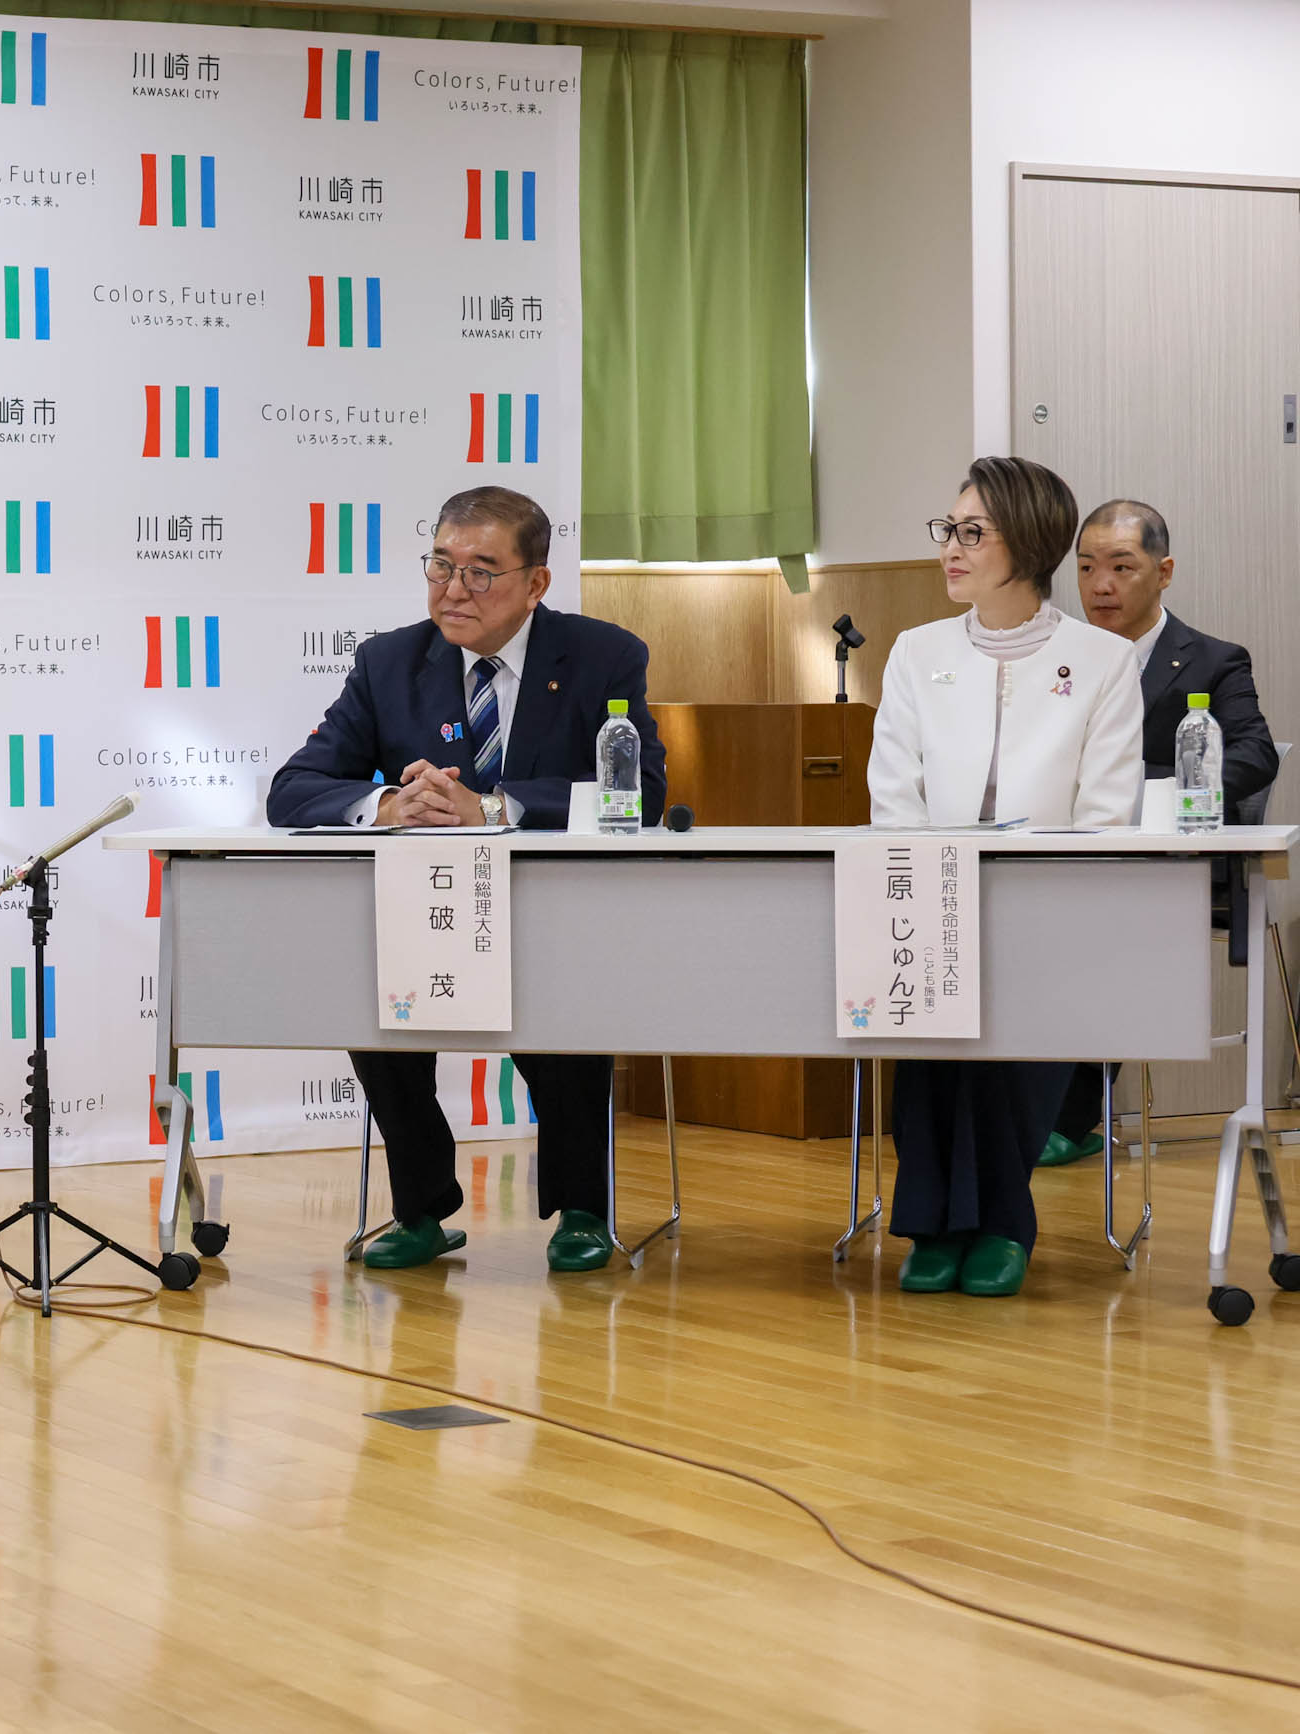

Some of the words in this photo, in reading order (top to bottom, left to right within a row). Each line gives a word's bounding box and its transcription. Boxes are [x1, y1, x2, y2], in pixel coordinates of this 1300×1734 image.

[133, 52, 220, 81] 川崎市
[133, 87, 188, 97] KAWASAKI
[195, 89, 219, 99] CITY
[498, 74, 575, 92] Future!
[10, 165, 94, 185] Future!
[300, 176, 382, 204] 川崎市
[299, 210, 353, 220] KAWASAKI
[359, 212, 382, 222] CITY
[183, 287, 264, 306] Future!
[462, 296, 541, 322] 川崎市
[462, 329, 514, 338] KAWASAKI
[520, 330, 542, 339] CITY
[348, 406, 426, 424] Future!
[30, 434, 55, 443] CITY
[137, 515, 223, 542] 川崎市
[137, 550, 192, 559] KAWASAKI
[198, 550, 222, 559] CITY
[16, 634, 99, 651] Future!
[303, 629, 390, 656] 川崎
[303, 664, 353, 674] KAWASAK
[187, 746, 268, 763] Future!
[886, 848, 914, 900] 三原
[429, 865, 455, 931] 石破
[474, 844, 492, 953] 内閣総理大臣
[941, 845, 960, 996] 内閣府特命担当大臣
[888, 917, 916, 1026] じゅん子
[429, 973, 455, 998] 茂
[302, 1077, 356, 1106] 川崎
[19, 1093, 105, 1115] Fture!
[305, 1110, 361, 1121] KAWASAKI
